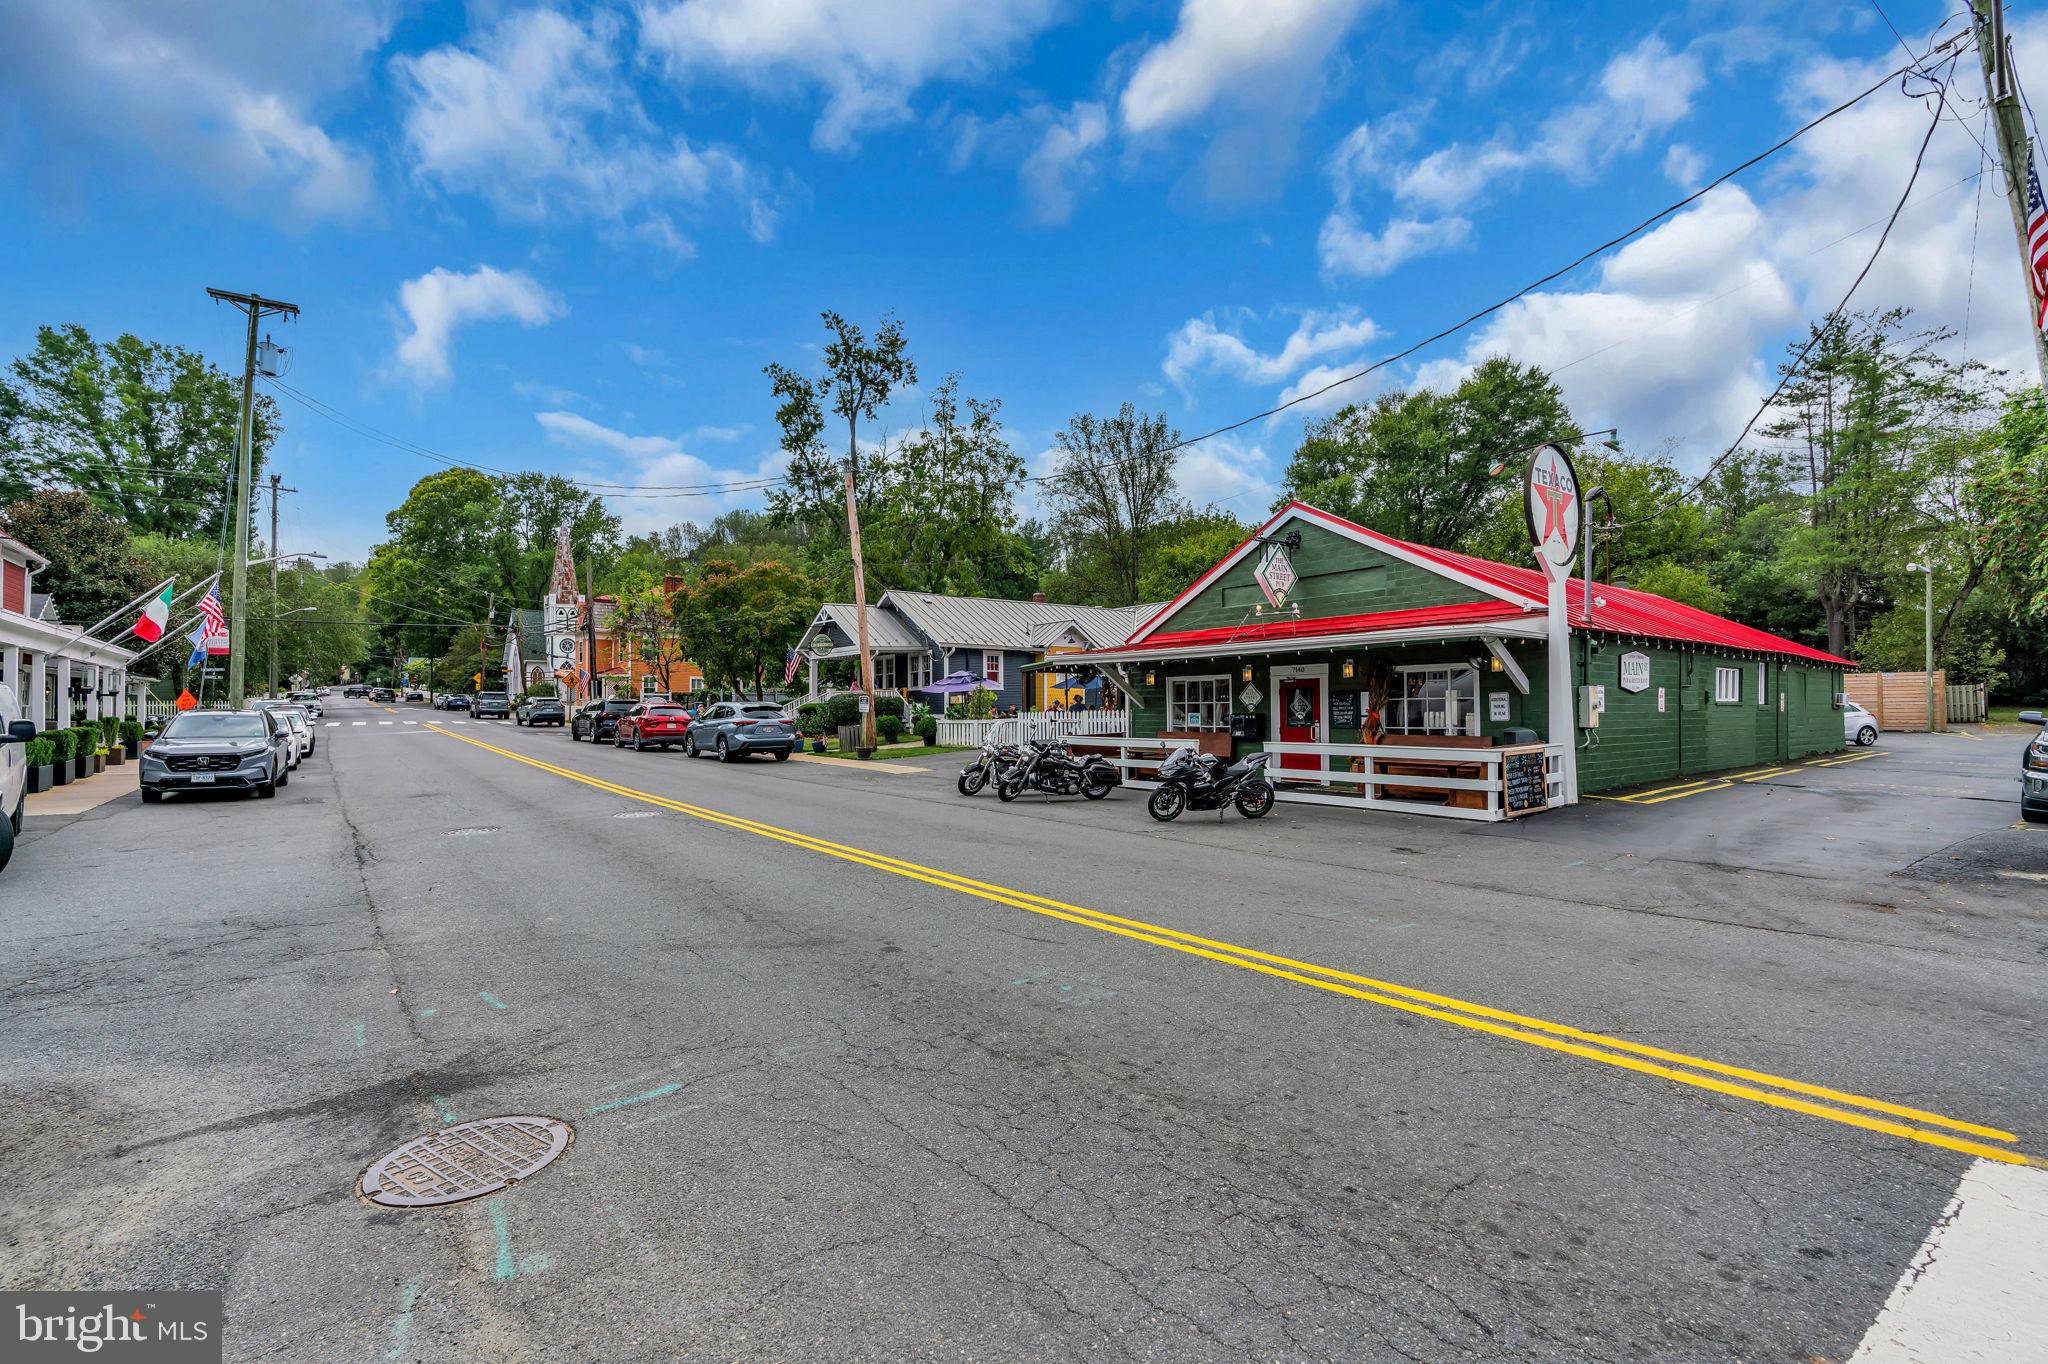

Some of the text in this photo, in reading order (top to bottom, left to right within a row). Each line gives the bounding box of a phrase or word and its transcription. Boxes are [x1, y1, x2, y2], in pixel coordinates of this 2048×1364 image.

[1534, 467, 1573, 493] TEXACO
[1271, 563, 1288, 573] MAIN
[1268, 571, 1291, 582] STREET
[1623, 661, 1643, 676] MAIN
